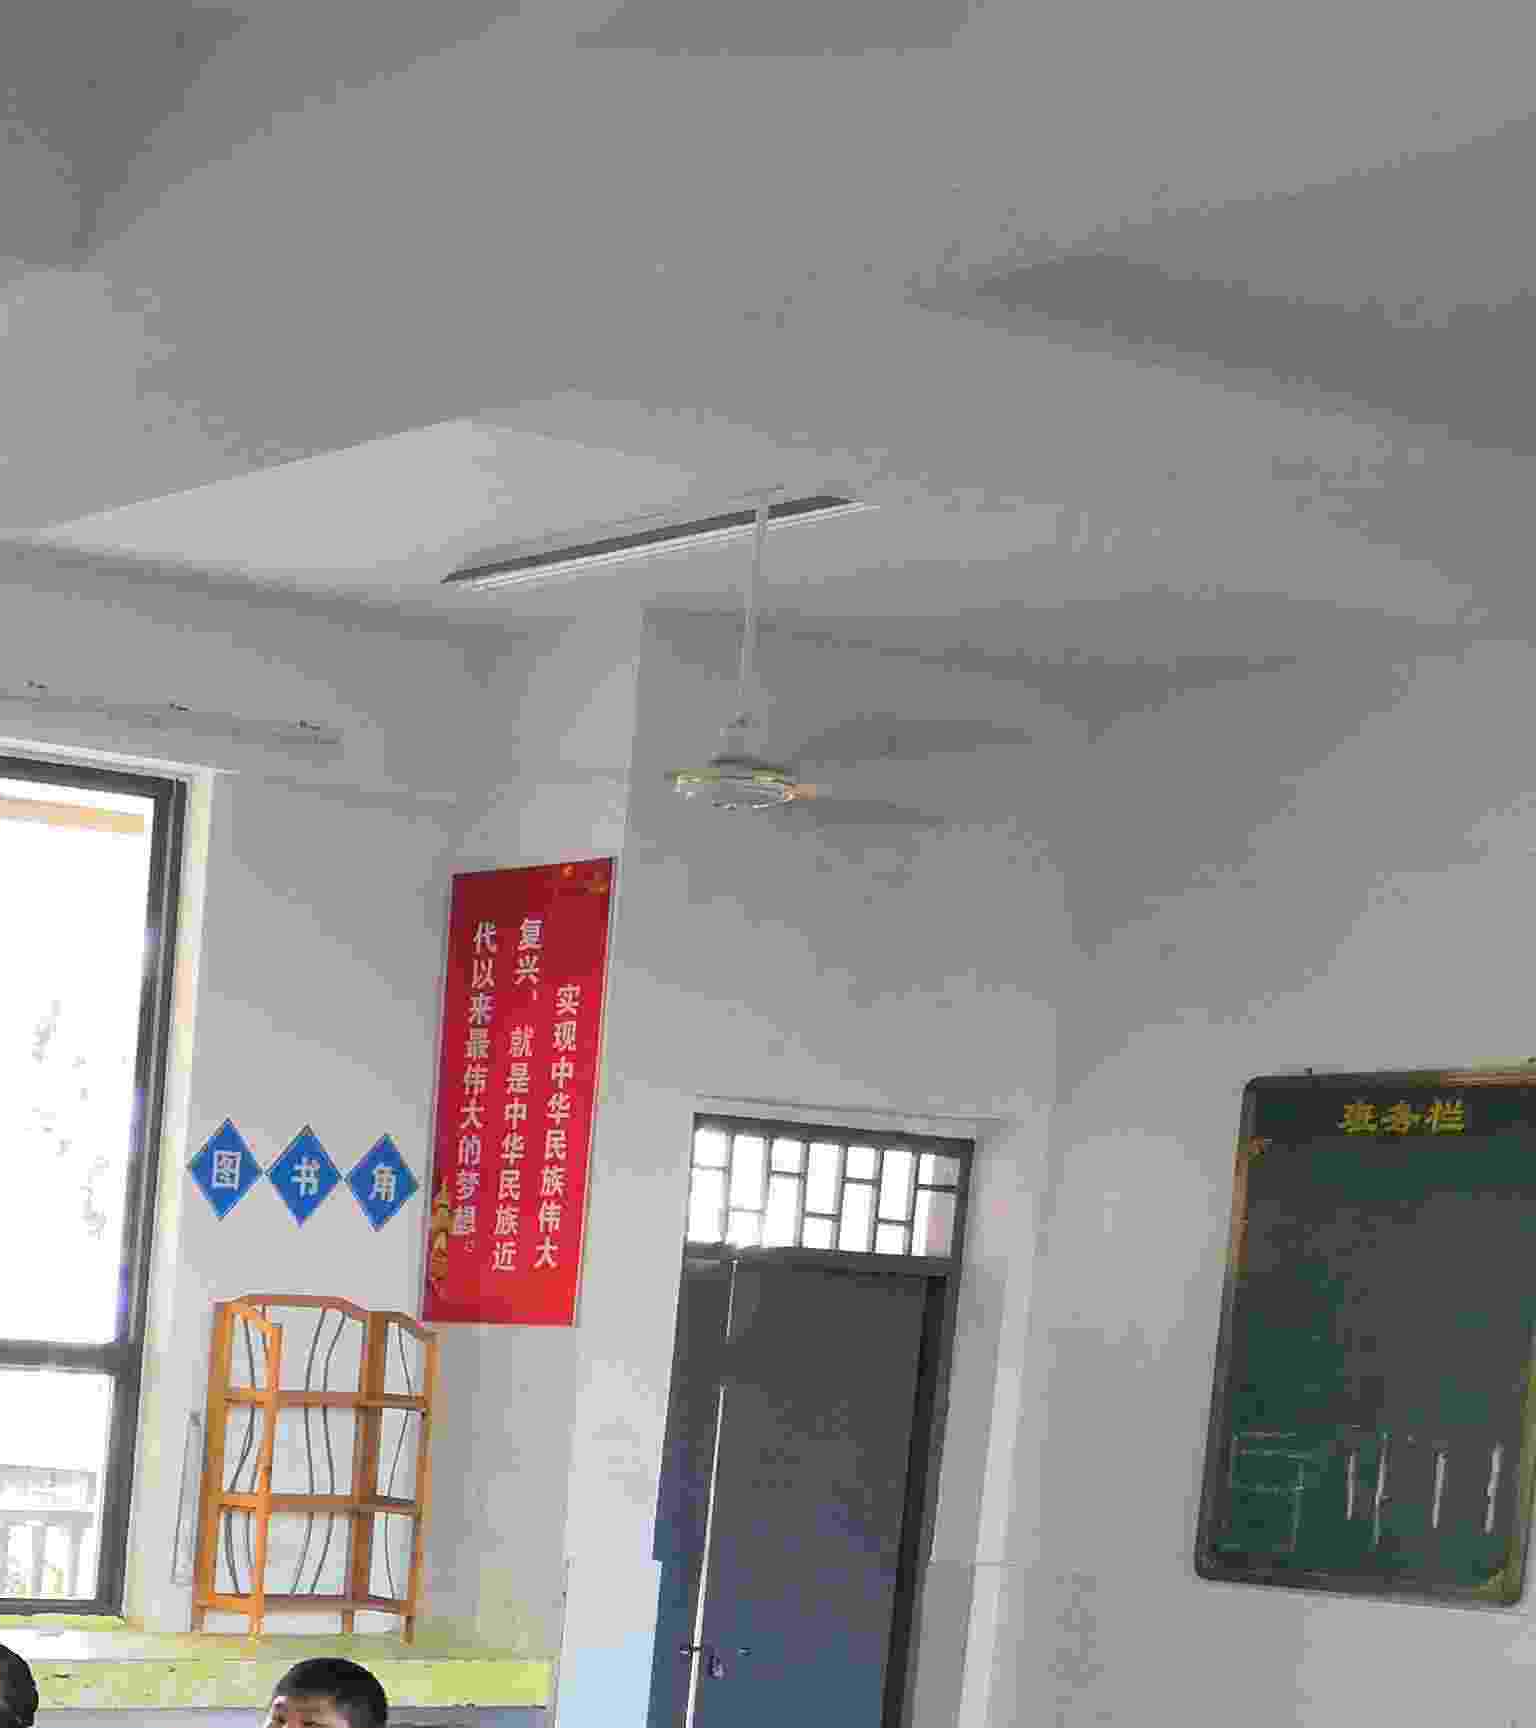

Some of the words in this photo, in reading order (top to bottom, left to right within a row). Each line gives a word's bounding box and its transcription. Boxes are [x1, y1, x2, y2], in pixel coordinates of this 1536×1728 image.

[211, 1150, 396, 1203] 图书角
[533, 983, 581, 1270] 实现中华民族伟大
